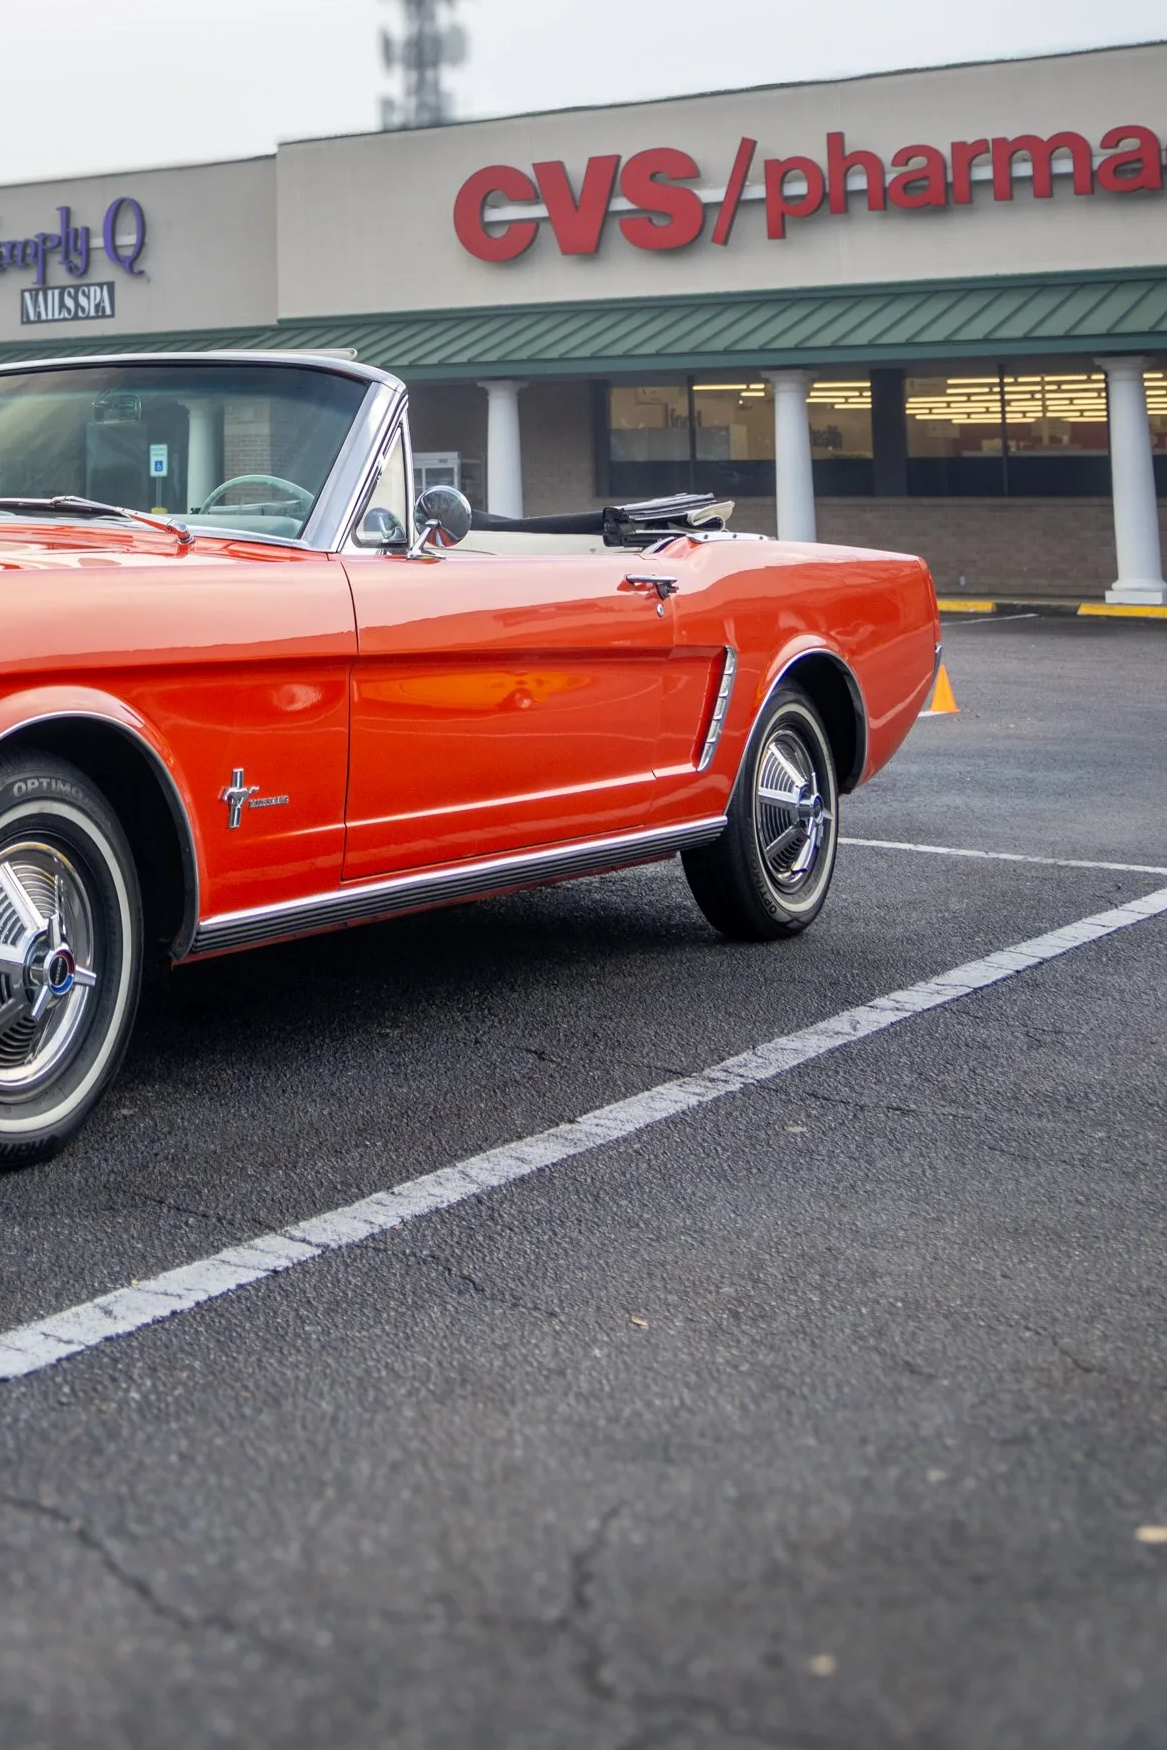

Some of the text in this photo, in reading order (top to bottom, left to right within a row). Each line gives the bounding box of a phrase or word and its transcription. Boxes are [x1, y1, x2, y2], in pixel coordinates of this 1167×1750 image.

[103, 196, 146, 276] Q
[23, 284, 112, 322] NAILS SPA
